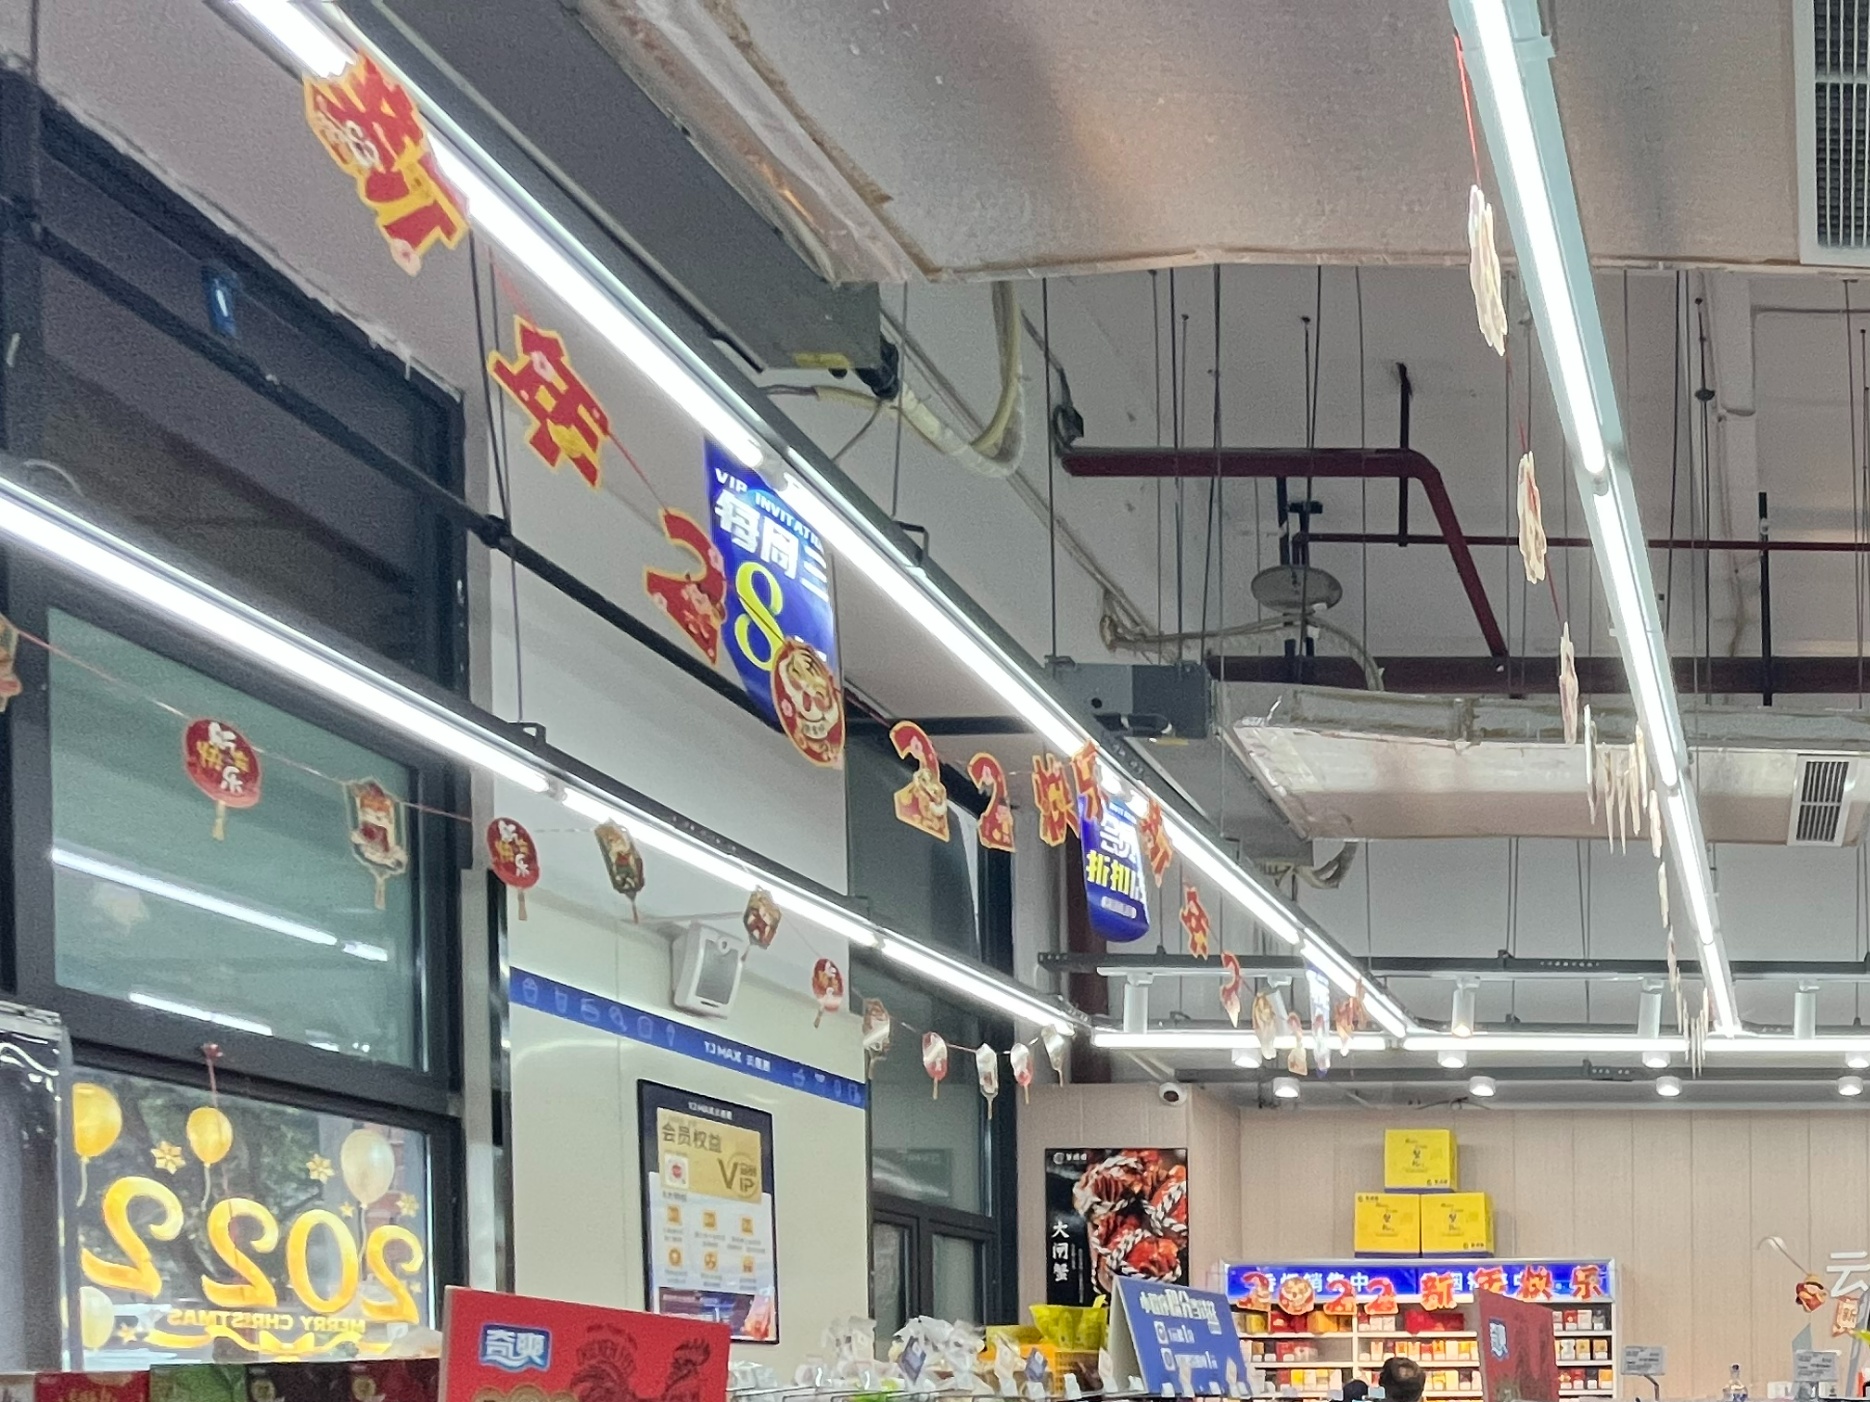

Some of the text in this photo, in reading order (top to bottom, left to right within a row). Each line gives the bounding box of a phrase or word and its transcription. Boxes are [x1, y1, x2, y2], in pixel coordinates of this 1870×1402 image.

[714, 469, 748, 494] VIP
[734, 560, 785, 672] 8
[661, 1121, 724, 1155] 会员权益
[1051, 1219, 1070, 1283] 大闸蟹
